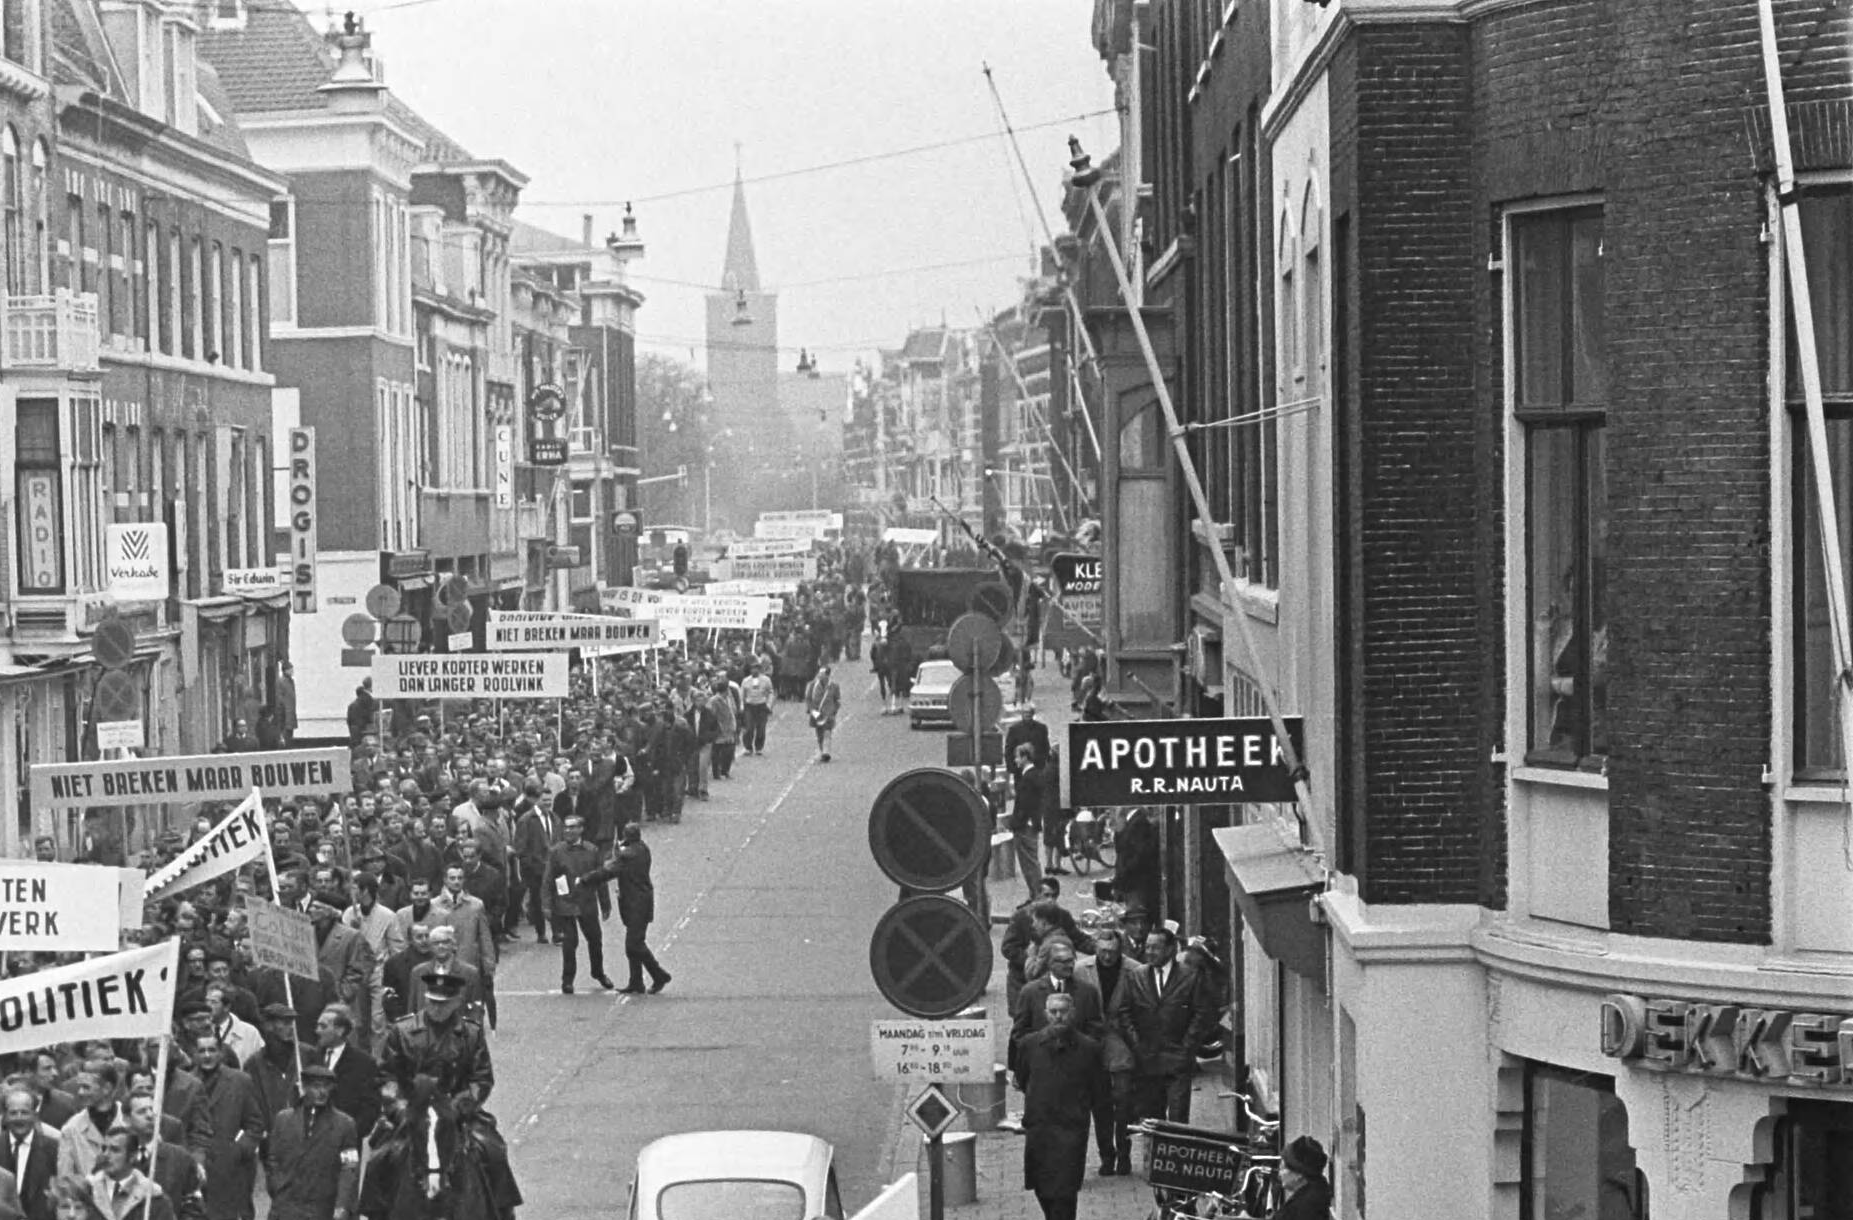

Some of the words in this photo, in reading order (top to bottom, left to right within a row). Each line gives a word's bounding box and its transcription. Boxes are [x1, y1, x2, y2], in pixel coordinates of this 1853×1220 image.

[292, 428, 315, 611] DROGIST
[32, 483, 50, 587] RADIO
[110, 565, 159, 578] Verkade
[243, 572, 275, 584] Edwin
[1075, 562, 1102, 578] KLE
[496, 628, 518, 642] NIET
[605, 624, 649, 640] BOUWEN
[399, 660, 438, 676] LIEVER
[441, 660, 489, 676] KORTER
[492, 659, 544, 676] WERKEN
[399, 677, 424, 693] DAN
[427, 676, 476, 693] LANGER
[483, 676, 544, 692] ROOLVINK
[50, 773, 94, 800] NIET
[185, 765, 243, 792] MAAR
[251, 760, 333, 788] BOUWEN
[879, 1028, 926, 1039] MAANDAG
[945, 1028, 986, 1038] VRIJDAG
[1157, 1142, 1236, 1166] APOTHEEK
[1182, 1164, 1233, 1180] NAUTA
